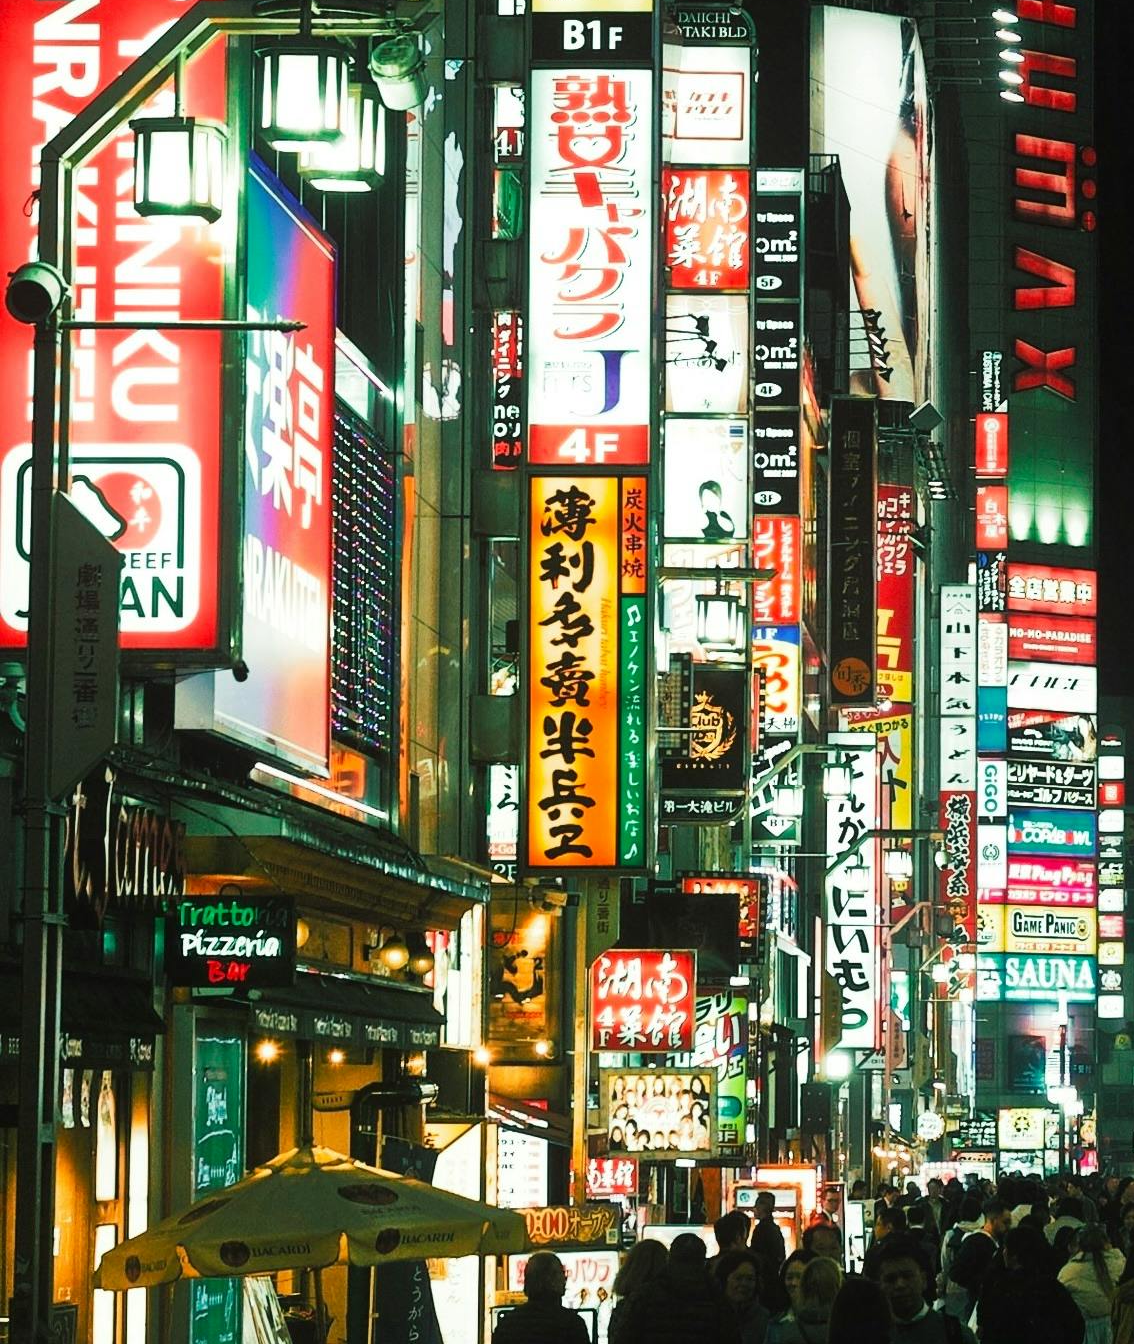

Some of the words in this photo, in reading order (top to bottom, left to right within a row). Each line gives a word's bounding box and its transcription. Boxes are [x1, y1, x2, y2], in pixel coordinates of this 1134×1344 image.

[678, 11, 731, 24] DAIICHI
[718, 26, 748, 39] BLD
[561, 18, 623, 52] B1F
[539, 73, 648, 344] 熟女キャバクラ
[668, 173, 748, 225] 湖南
[669, 224, 748, 271] 菜館
[693, 269, 723, 287] 4F
[759, 276, 777, 289] 5F
[759, 384, 775, 395] 4F
[558, 428, 620, 463] 4F
[759, 493, 775, 504] 3F
[622, 488, 646, 579] 炭火串焼
[1008, 574, 1093, 606] 全店営業中
[72, 563, 103, 729] 劇場通り一番街
[984, 764, 998, 813] GiGO
[1007, 763, 1094, 787] ビリヤード&ダーツ
[831, 753, 870, 1030] とんかにいむら
[180, 928, 282, 958] Pizzeria
[597, 952, 688, 1006] 湖南
[1005, 957, 1095, 988] SAUNA
[616, 1004, 684, 1049] 菜館
